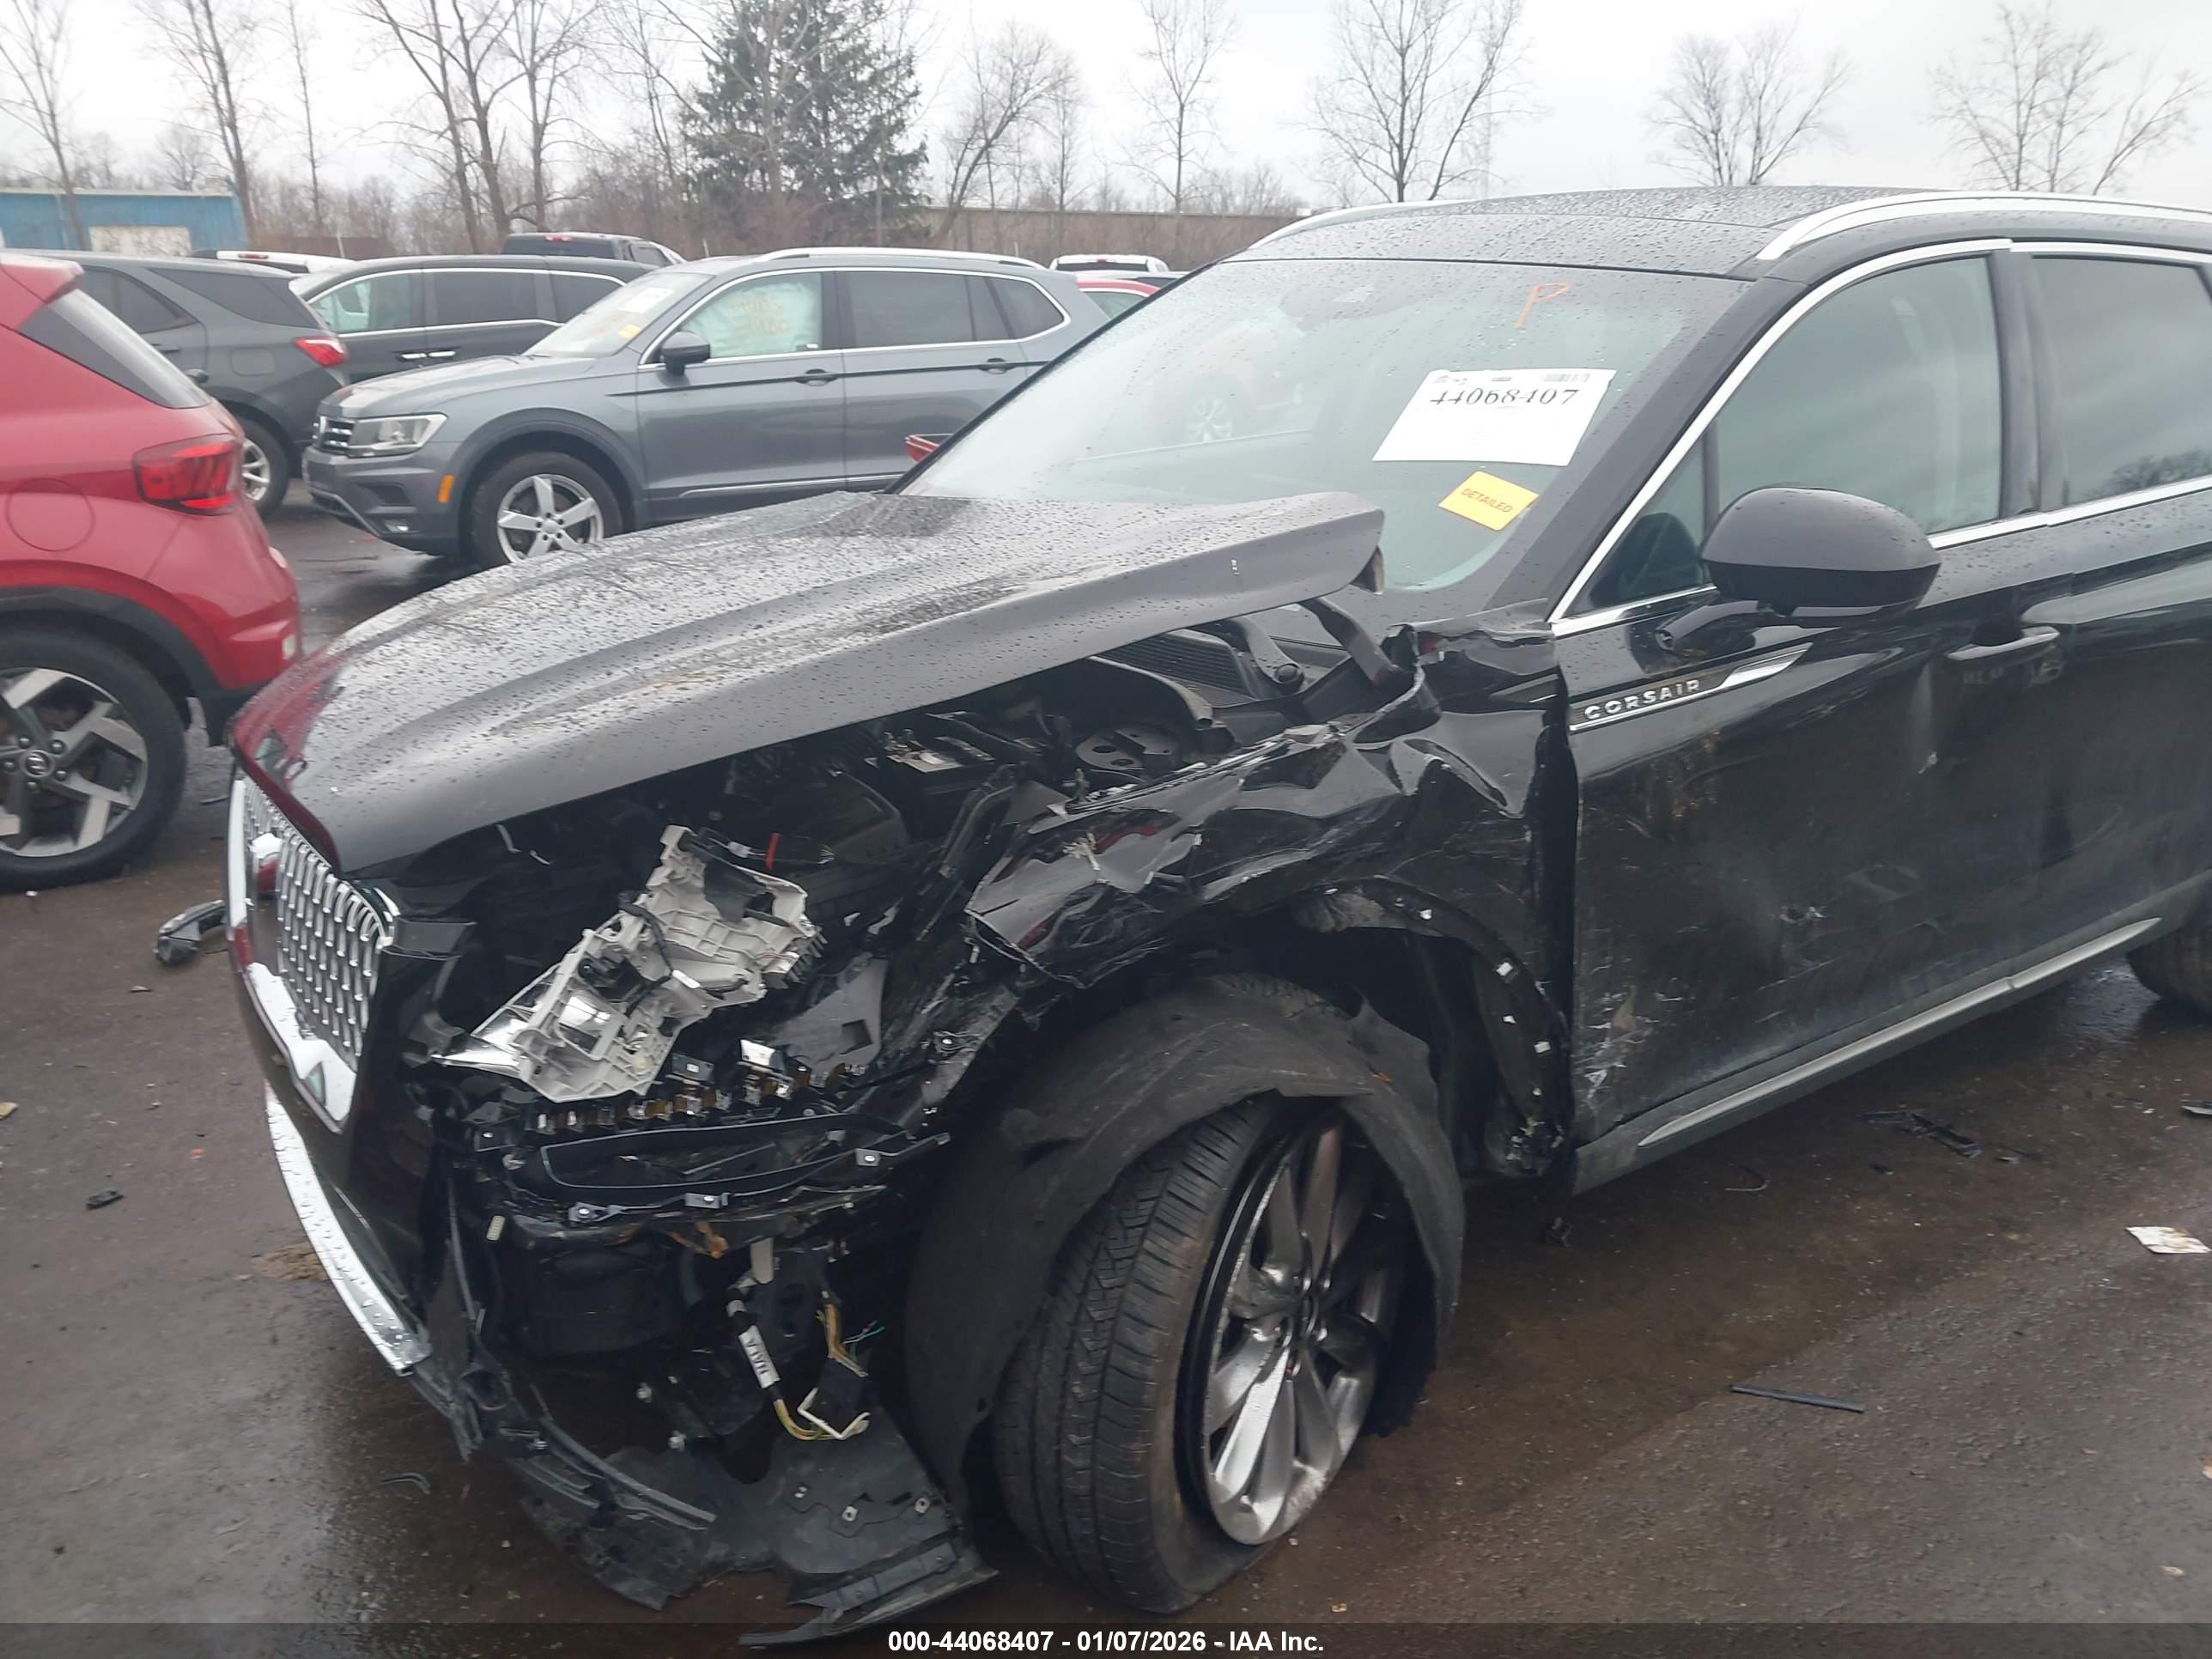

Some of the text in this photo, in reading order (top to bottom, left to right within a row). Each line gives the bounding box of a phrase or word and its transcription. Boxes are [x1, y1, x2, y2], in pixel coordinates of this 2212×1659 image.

[1514, 282, 1571, 330] P
[1430, 388, 1580, 405] 44068407
[1460, 488, 1513, 514] DETAILED
[1584, 679, 1701, 720] CORSAIR
